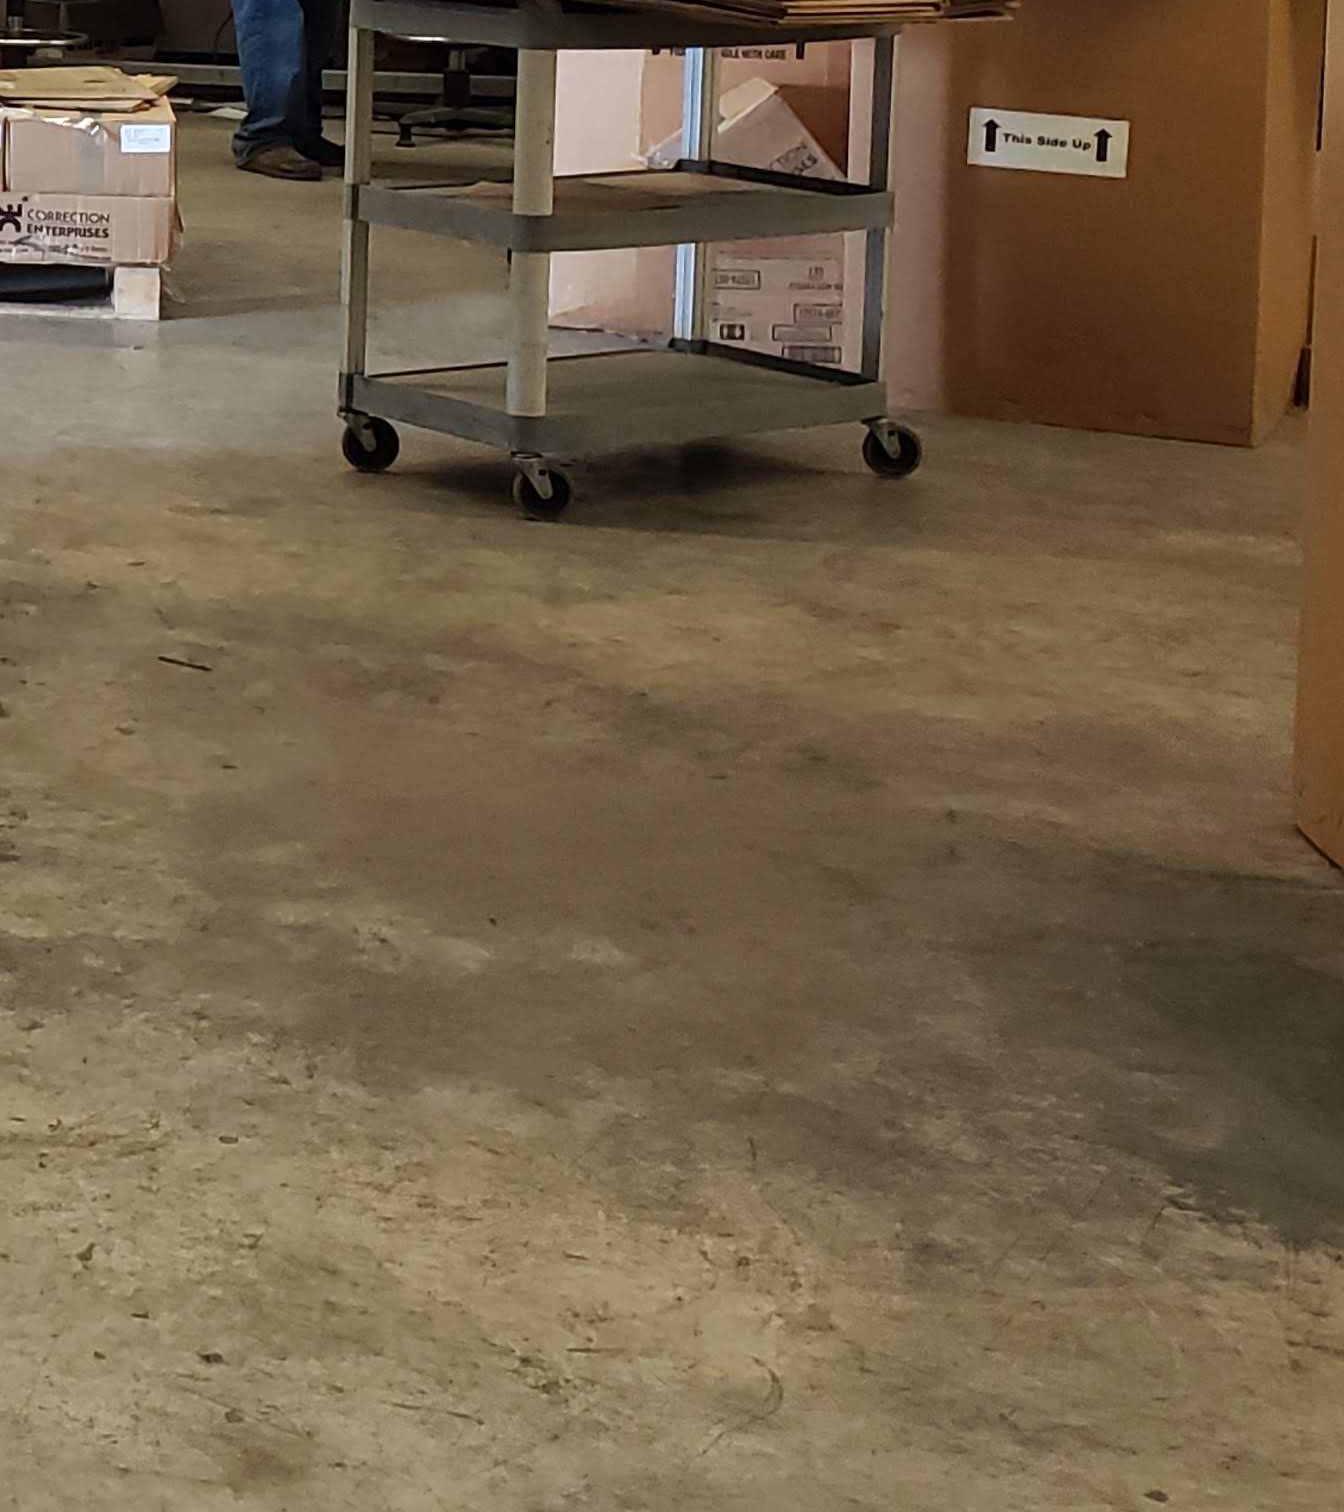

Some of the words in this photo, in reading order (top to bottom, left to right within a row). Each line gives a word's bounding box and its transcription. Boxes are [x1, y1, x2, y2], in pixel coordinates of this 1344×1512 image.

[1003, 131, 1032, 145] This
[1037, 135, 1067, 148] Side
[1072, 139, 1092, 151] Up
[27, 209, 110, 224] CORRECTION
[26, 224, 109, 239] ENTERPRISES
